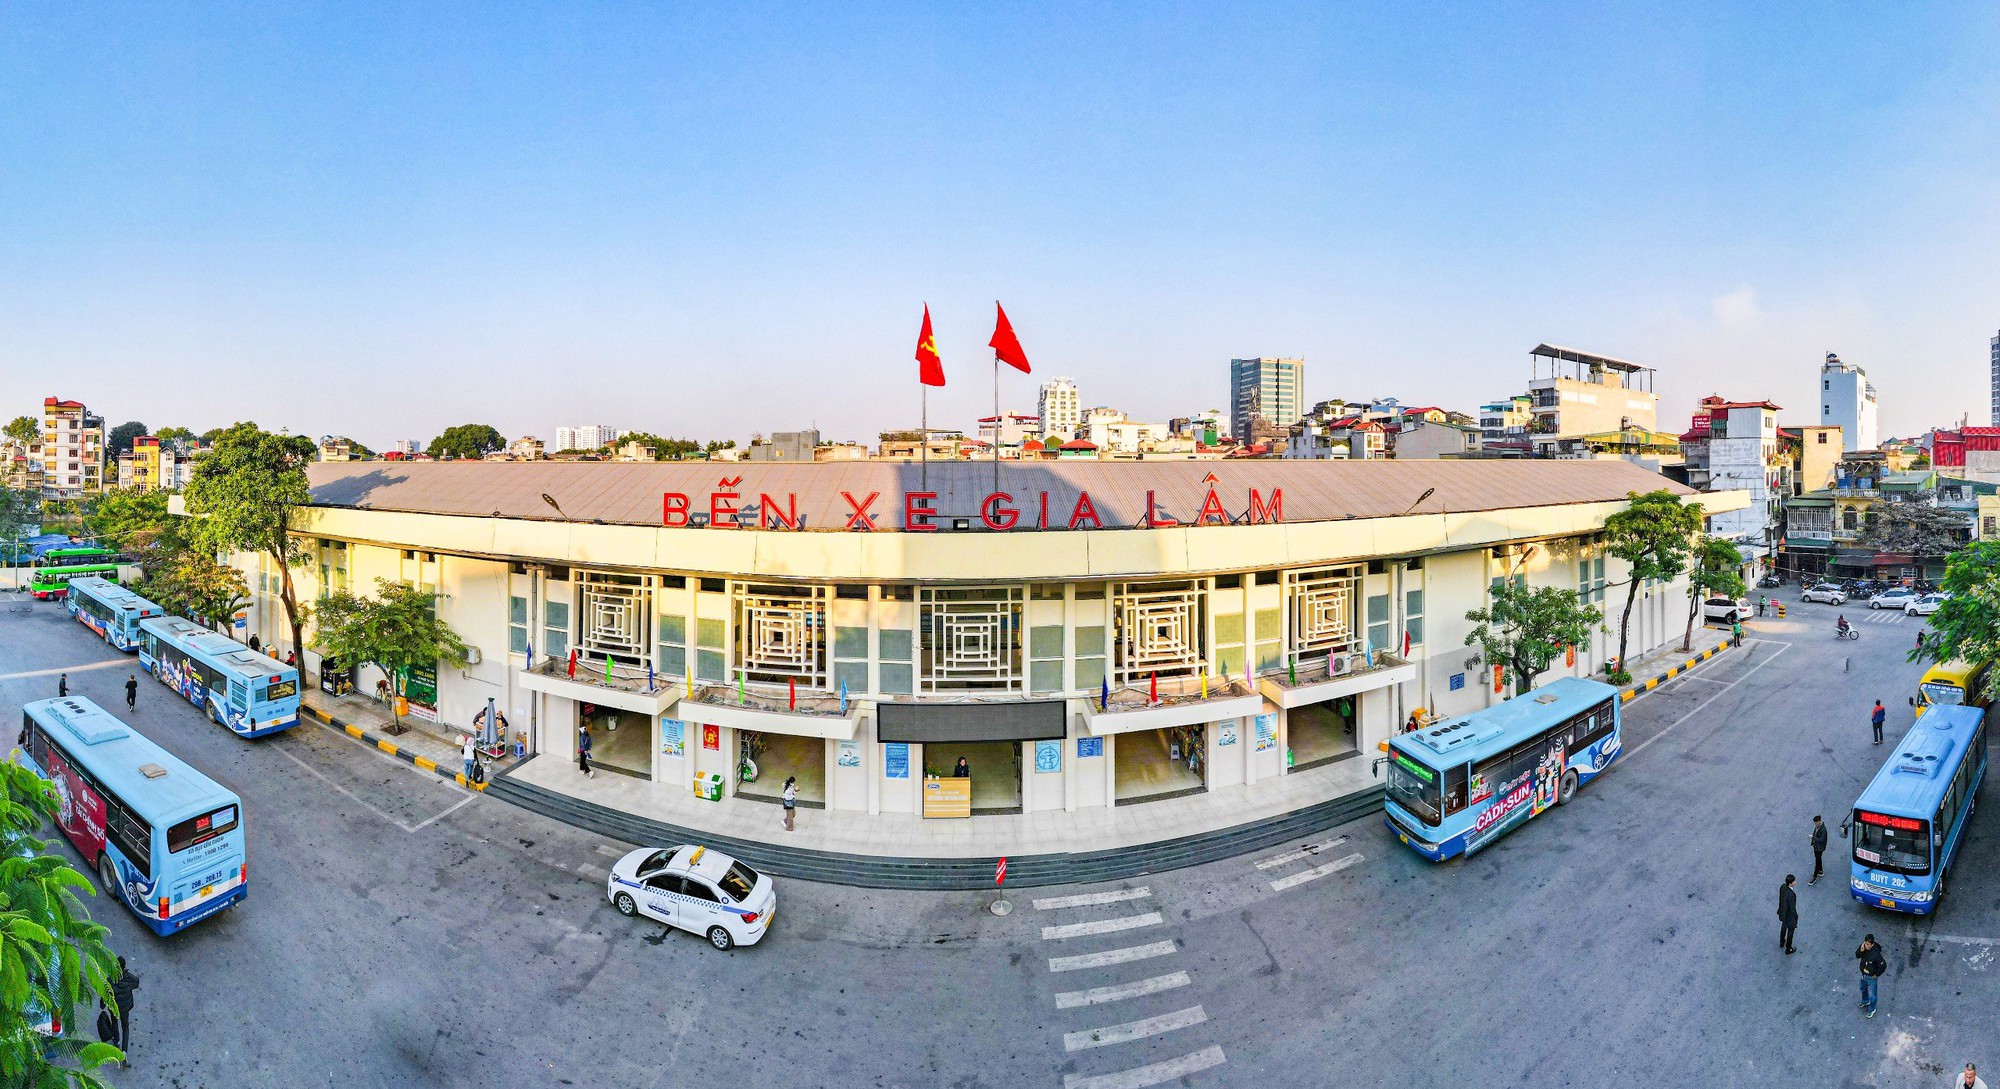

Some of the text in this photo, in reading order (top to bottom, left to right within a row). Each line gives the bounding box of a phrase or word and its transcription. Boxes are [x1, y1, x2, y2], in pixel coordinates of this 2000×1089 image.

[663, 471, 1283, 531] BẾN XE GIA LÂM
[1476, 783, 1530, 831] CADI-SUN
[1870, 872, 1906, 888] BUÝT 202
